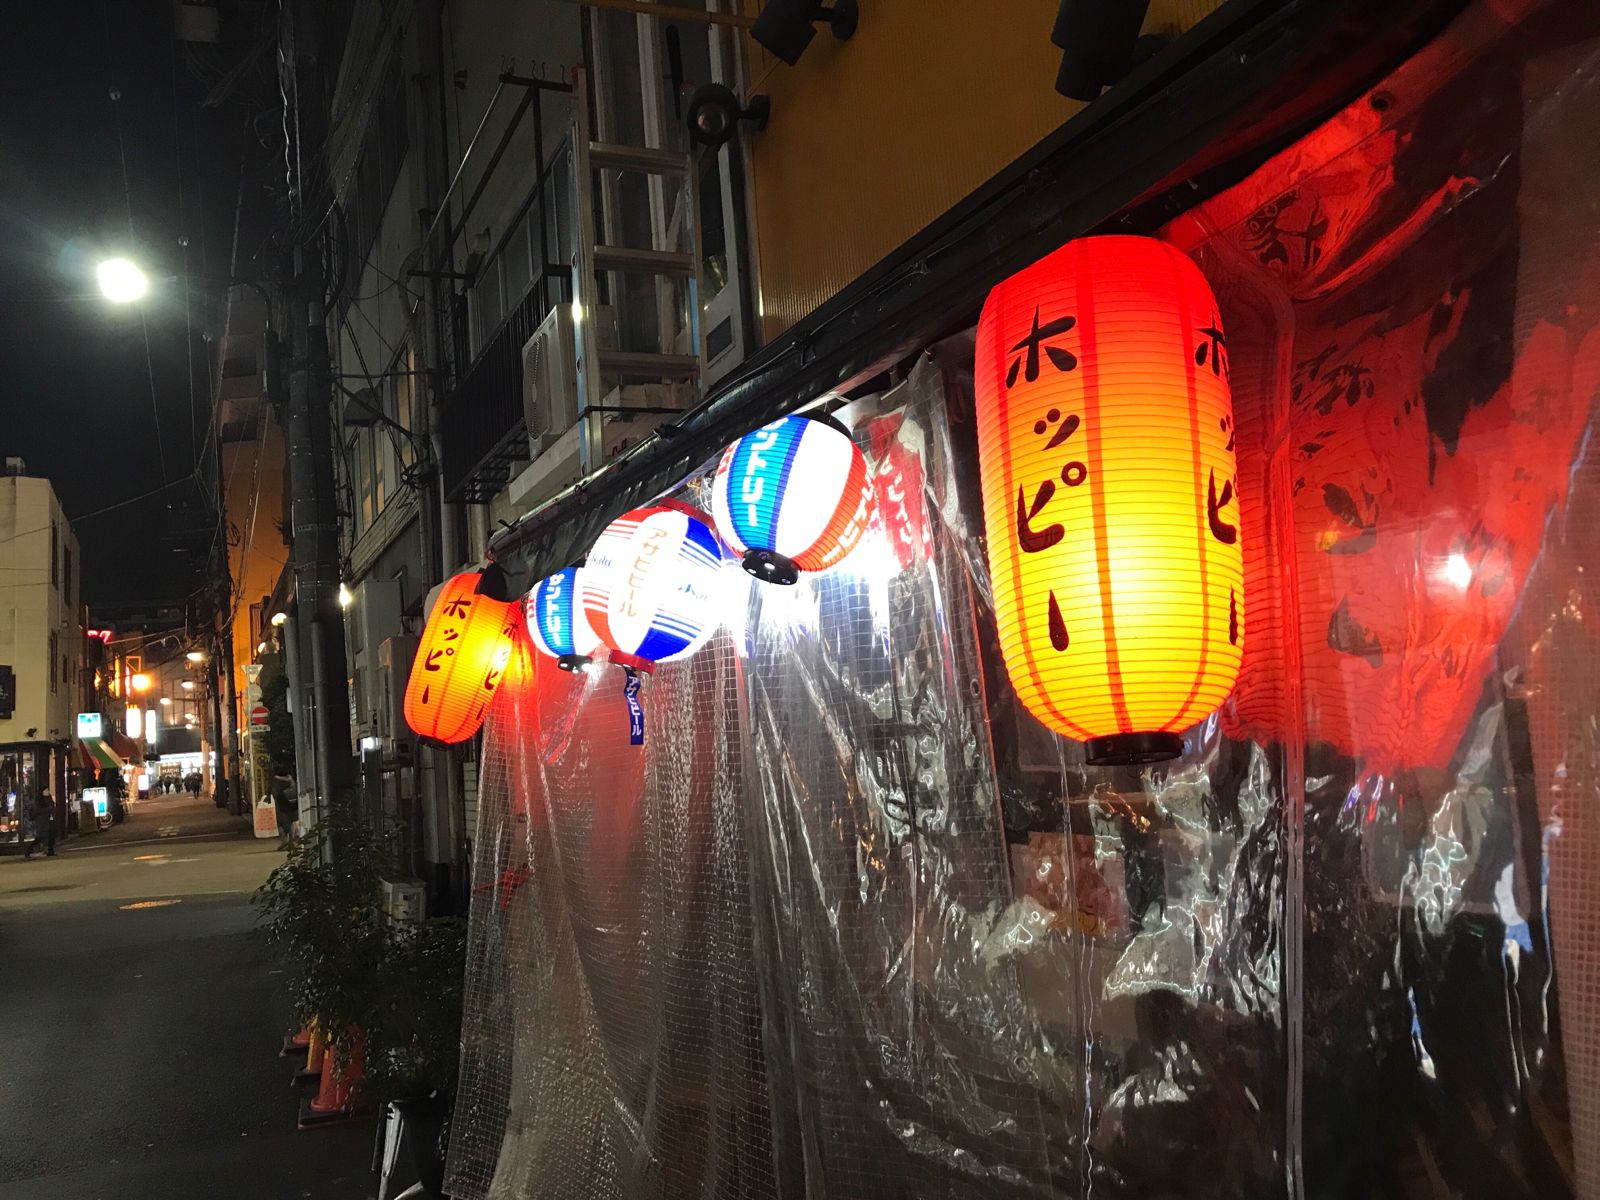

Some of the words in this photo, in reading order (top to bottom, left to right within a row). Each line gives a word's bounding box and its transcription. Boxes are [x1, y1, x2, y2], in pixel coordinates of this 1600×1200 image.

[1006, 305, 1088, 652] ホッピー
[424, 594, 471, 704] ホッピー
